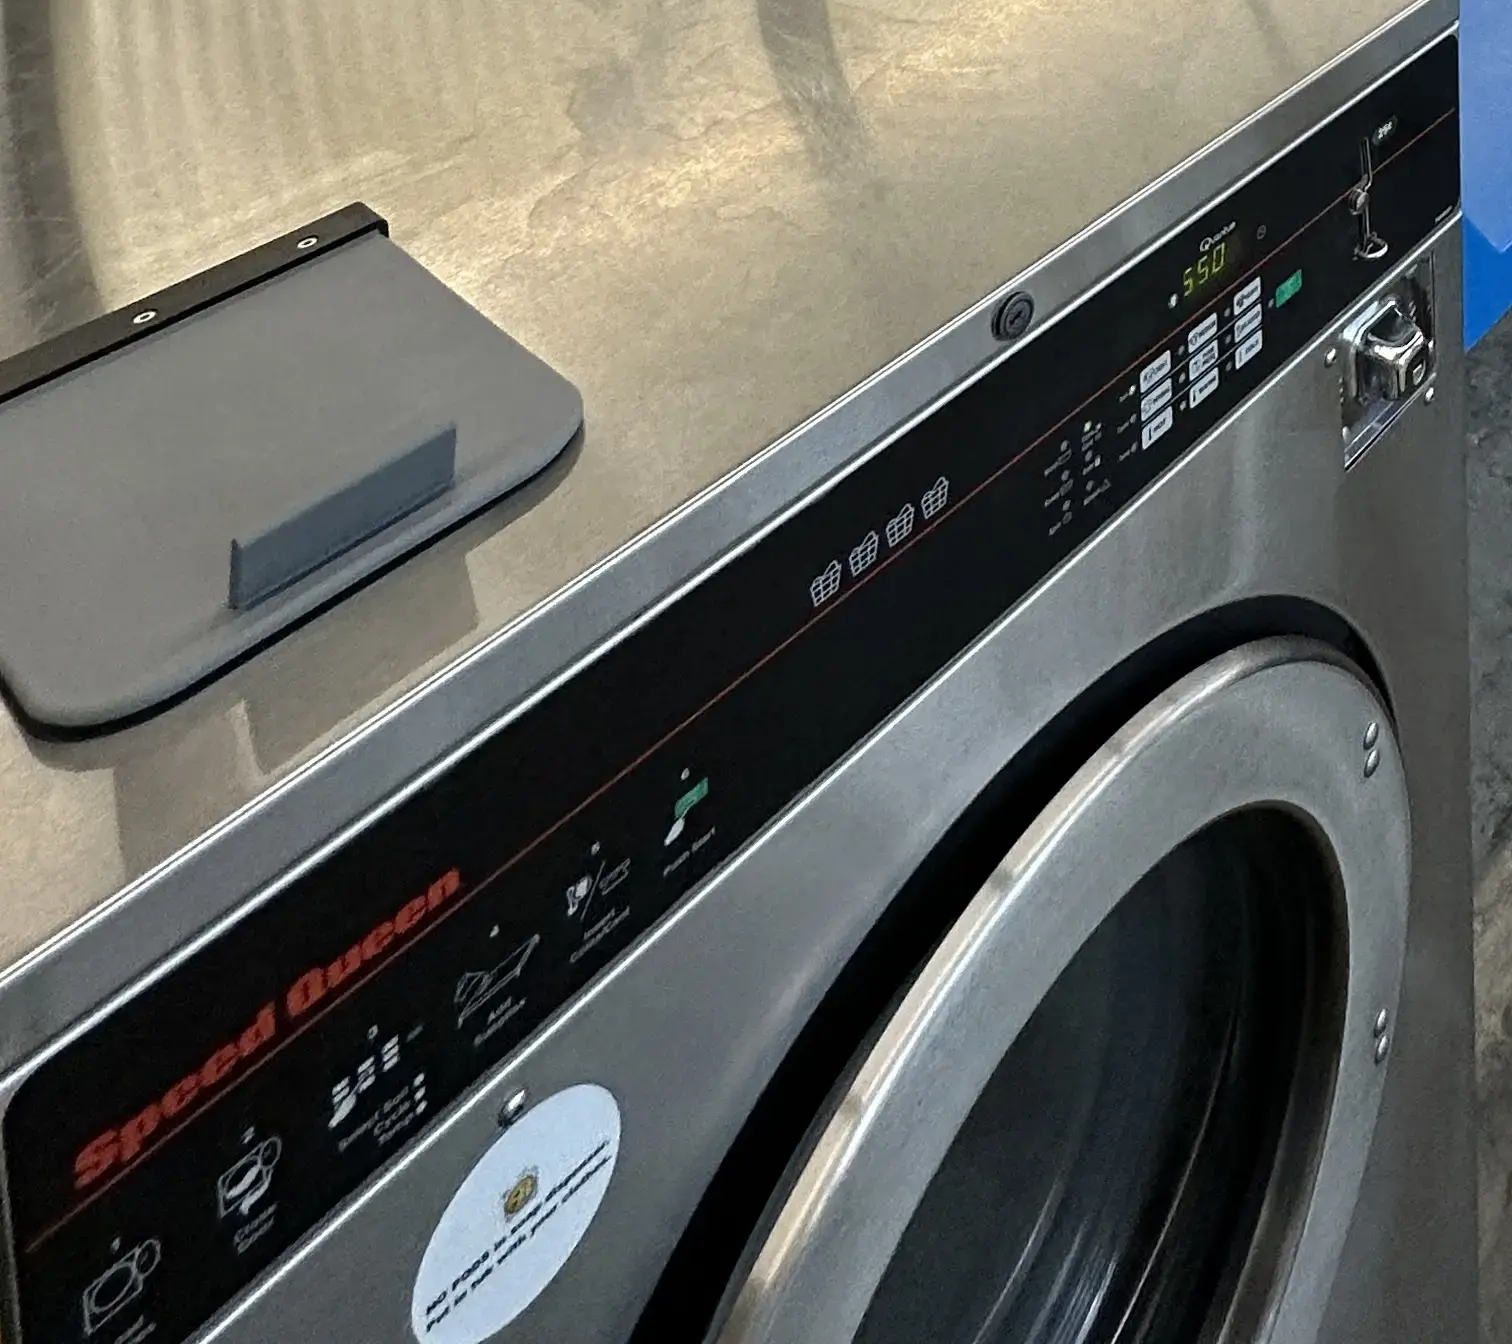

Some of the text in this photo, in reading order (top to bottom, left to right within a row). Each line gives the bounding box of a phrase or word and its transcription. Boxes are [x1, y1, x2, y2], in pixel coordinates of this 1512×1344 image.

[74, 868, 461, 1191] Speed Queen
[426, 1291, 447, 1315] NO
[452, 1250, 490, 1291] PODS
[494, 1235, 507, 1252] in
[511, 1201, 543, 1235] soap
[426, 1306, 450, 1333] Put
[454, 1290, 468, 1308] in
[497, 1234, 527, 1266] with
[530, 1203, 558, 1237] your
